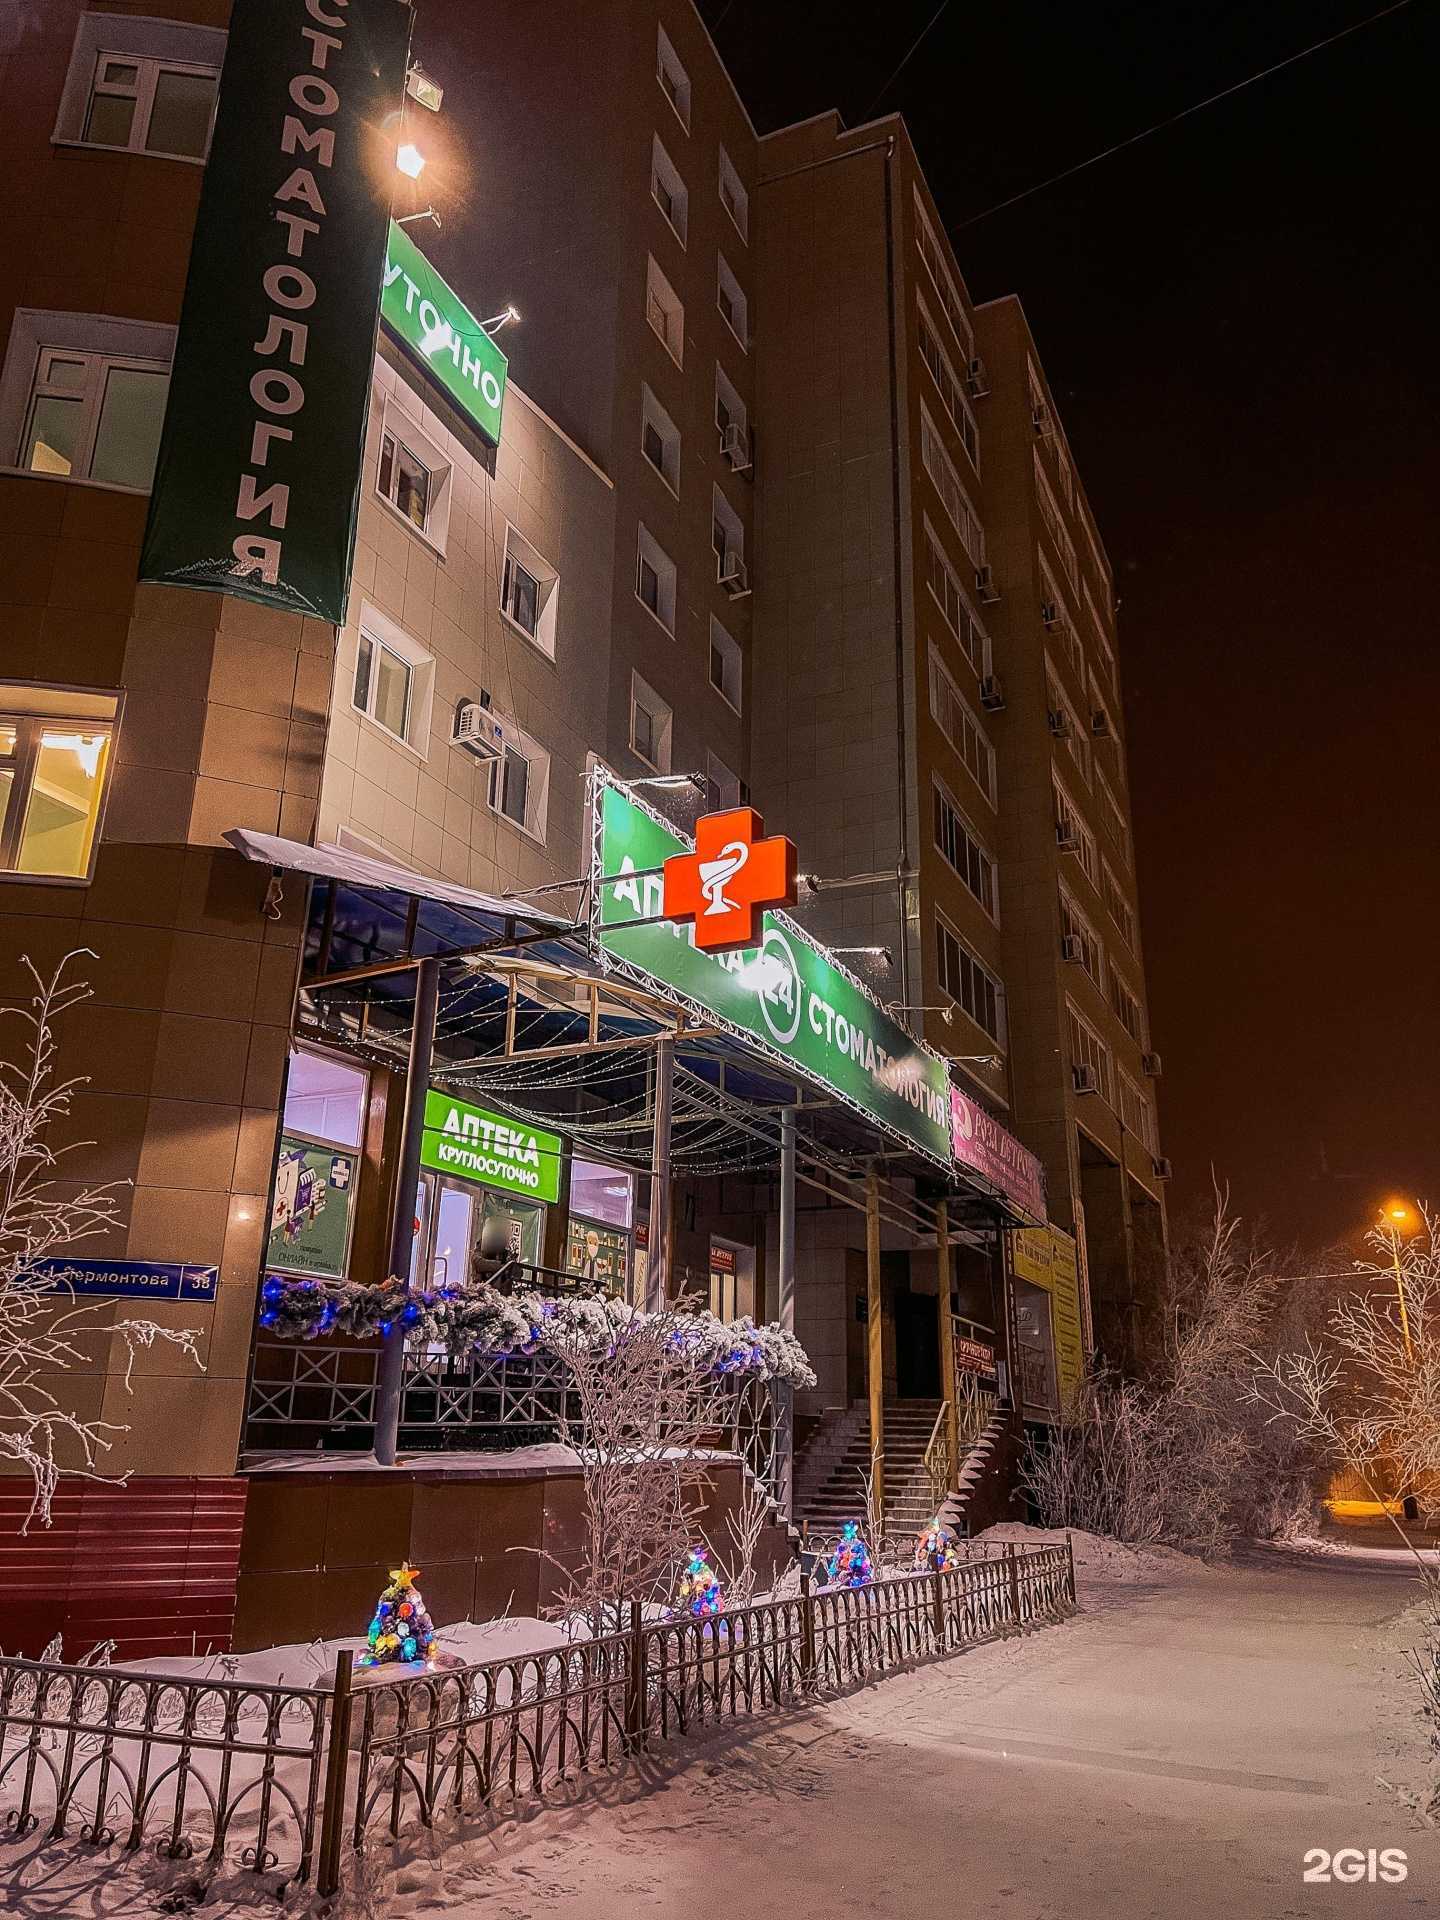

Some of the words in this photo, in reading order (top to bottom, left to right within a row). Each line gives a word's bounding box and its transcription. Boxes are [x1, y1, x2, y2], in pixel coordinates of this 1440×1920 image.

[228, 0, 349, 585] СТОМАТОЛОГИЯ
[439, 1143, 539, 1188] КРУГЛОСУТОЧНО
[442, 1108, 539, 1167] АПТЕКА
